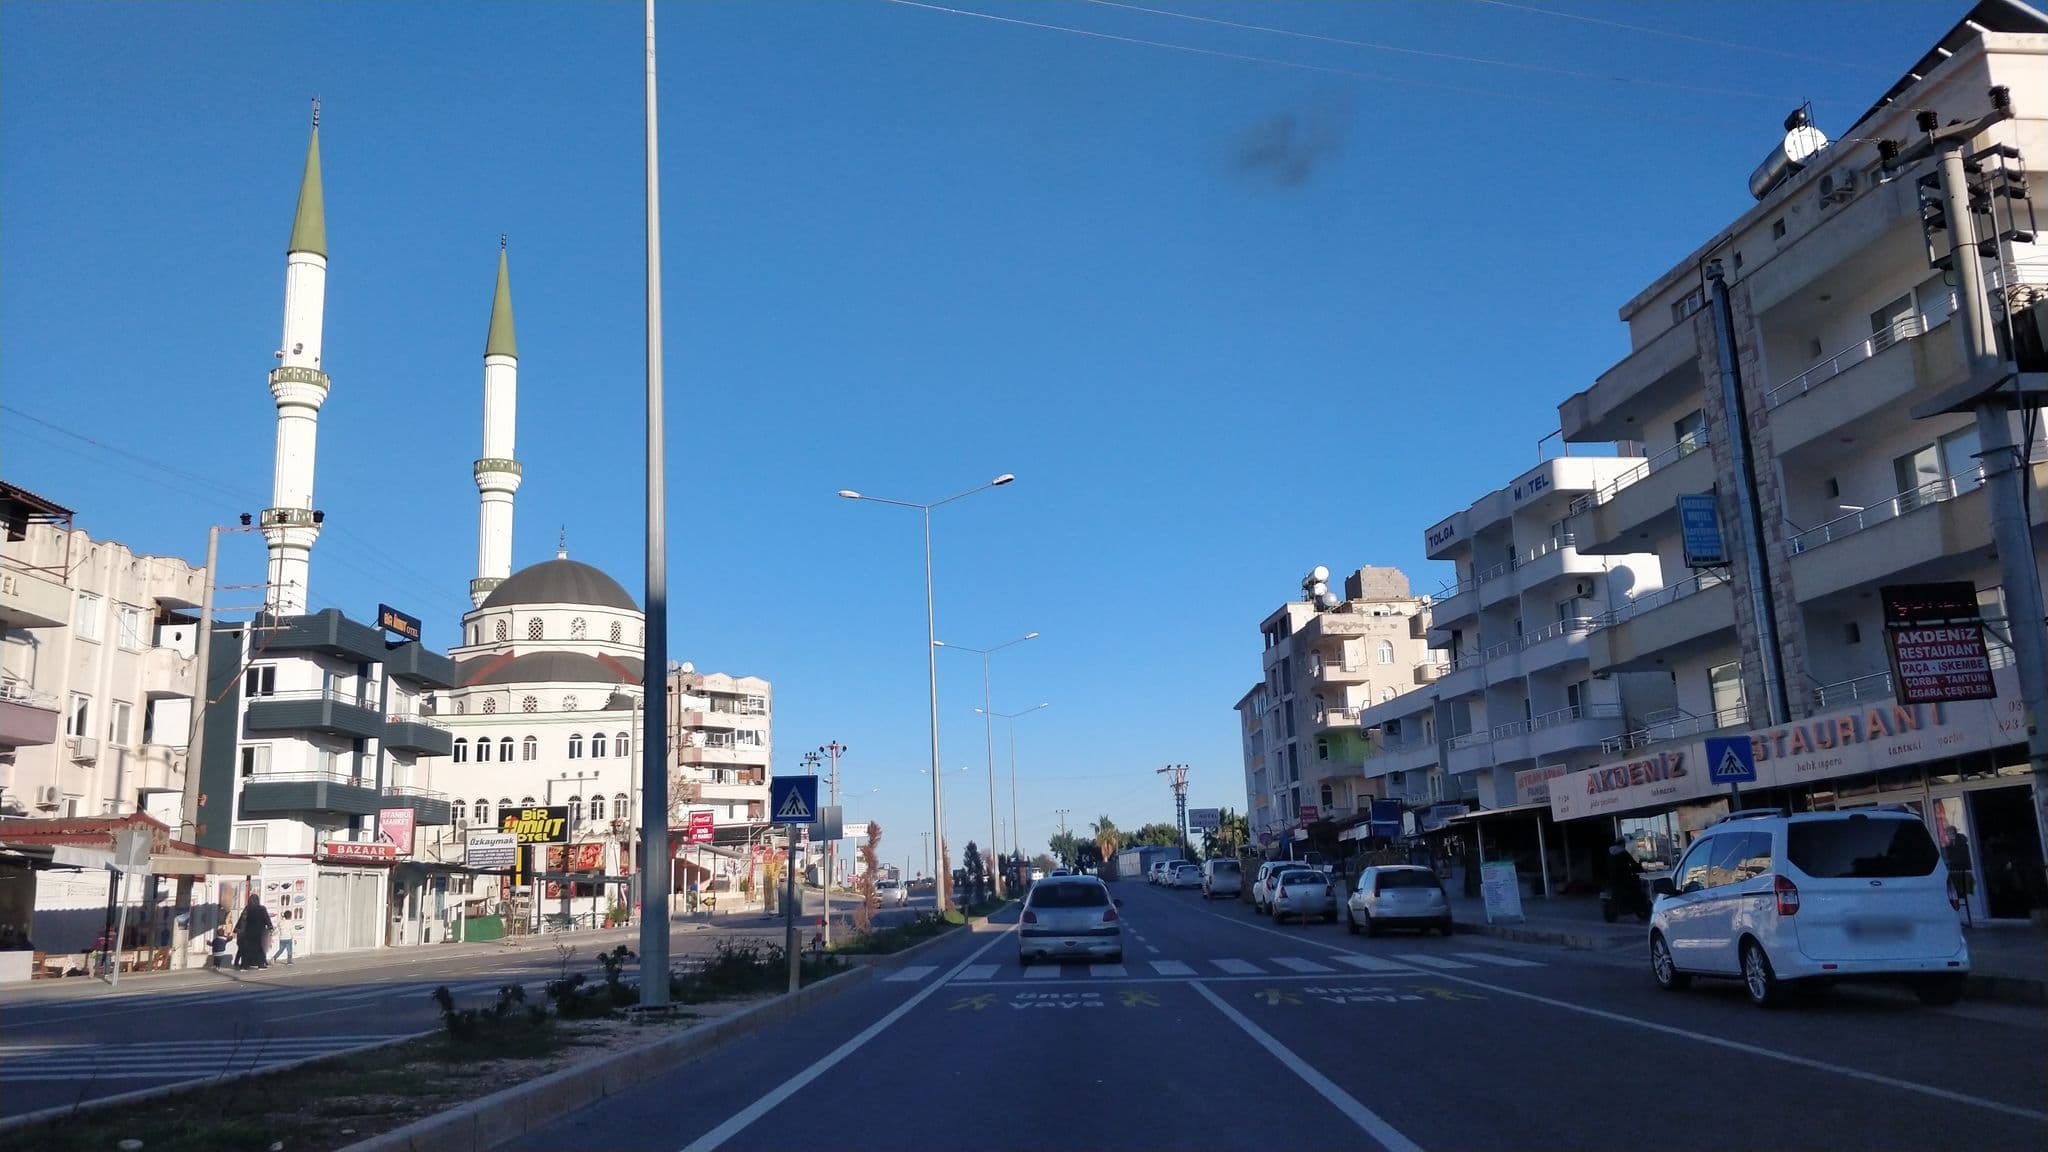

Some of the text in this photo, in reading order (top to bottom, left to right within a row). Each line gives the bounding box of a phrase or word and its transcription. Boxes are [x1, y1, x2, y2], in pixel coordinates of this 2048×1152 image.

[1429, 524, 1455, 547] TOLGA
[1899, 643, 1981, 660] RESTAURANT
[1902, 662, 1930, 675] PAÇA
[1905, 677, 1938, 689] ÇORBA
[337, 845, 386, 855] BAZAAR
